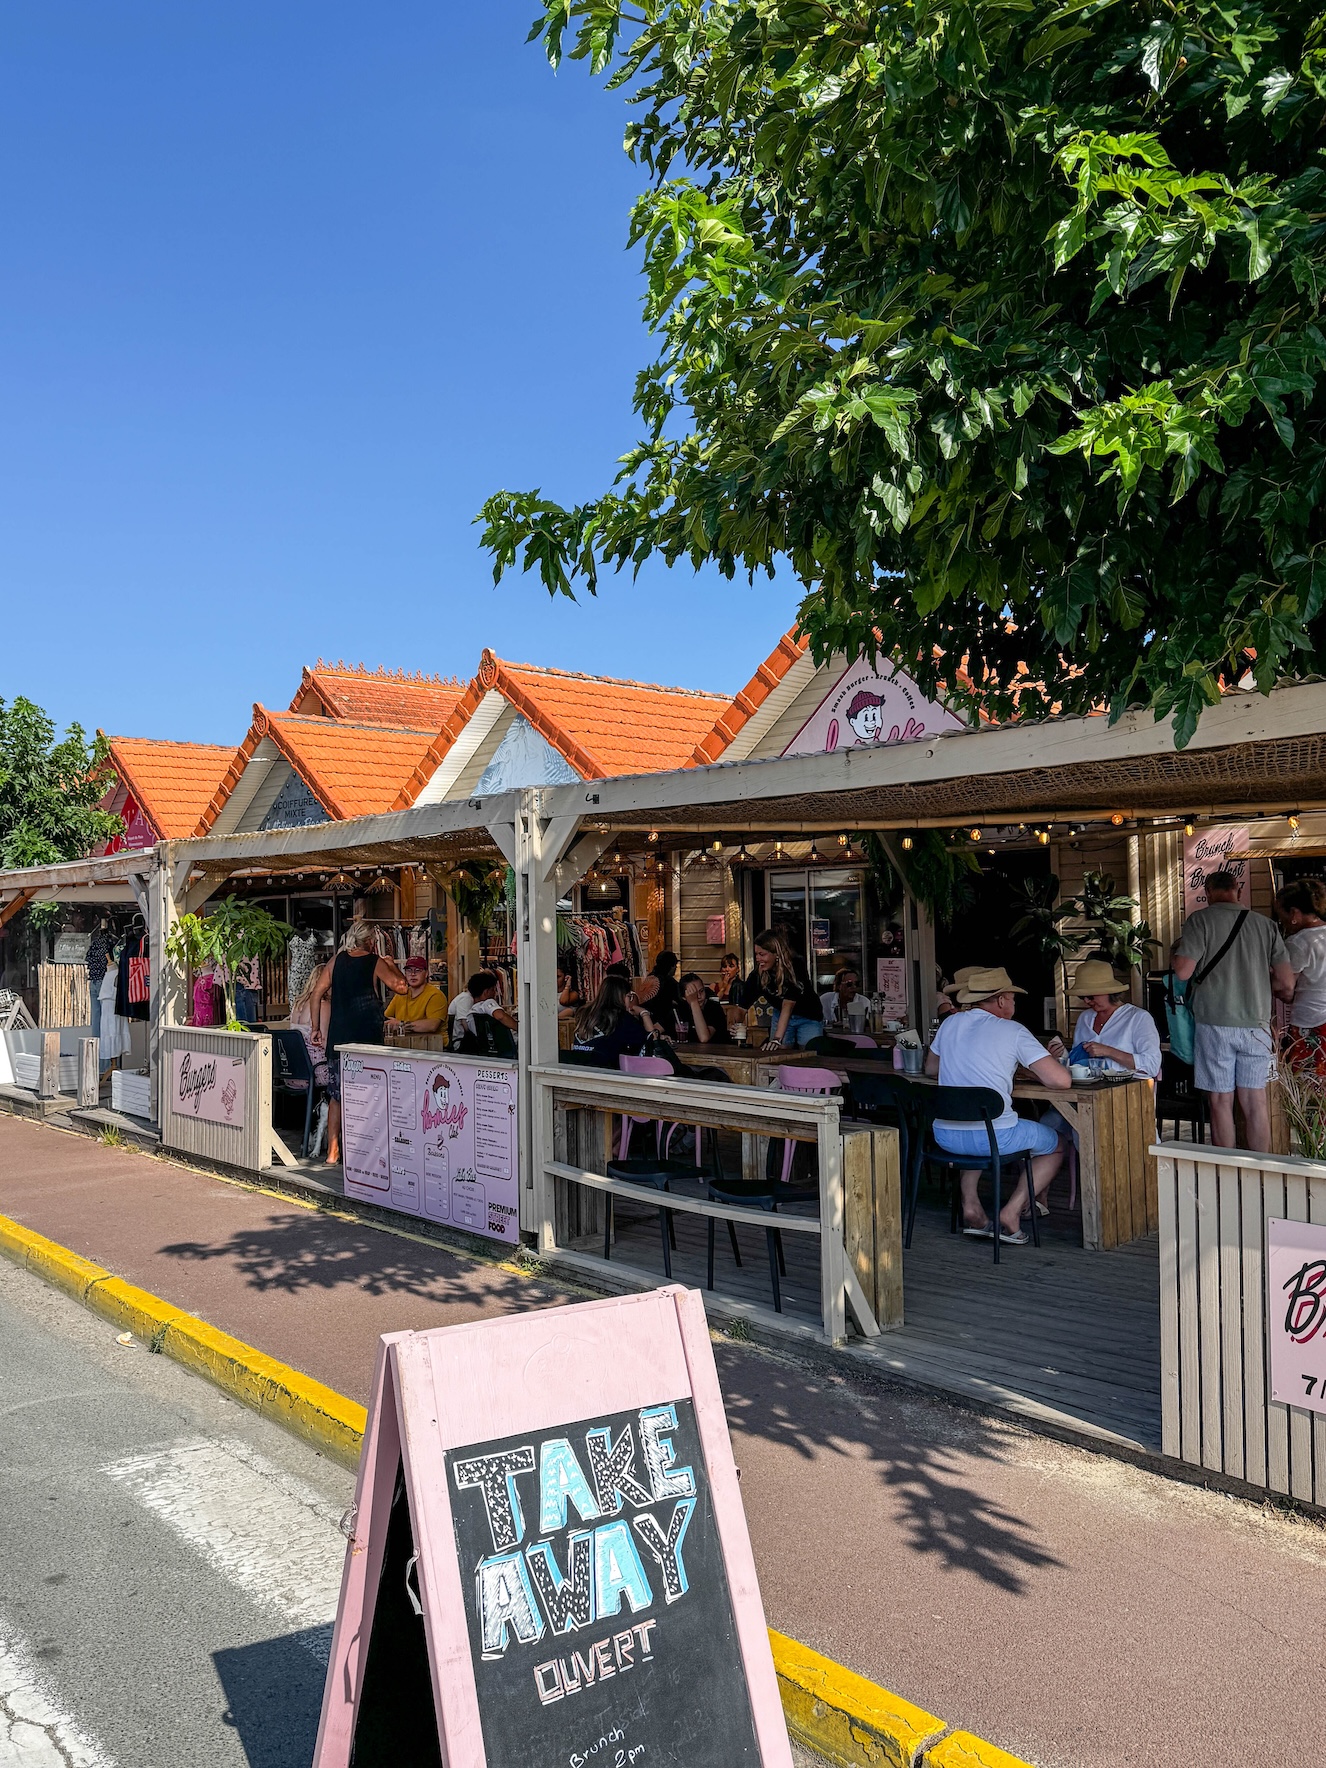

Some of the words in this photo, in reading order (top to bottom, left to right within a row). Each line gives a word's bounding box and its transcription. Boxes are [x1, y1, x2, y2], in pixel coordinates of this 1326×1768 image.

[846, 675, 869, 691] Burger
[277, 797, 314, 810] COIFFURE
[284, 808, 306, 818] MIXTE
[1195, 832, 1235, 860] Brunch
[179, 1052, 217, 1114] Burgers
[477, 1069, 508, 1080] DESSERTS
[488, 1202, 517, 1217] PREMIUM
[488, 1221, 506, 1234] FOOD
[1282, 1259, 1326, 1344] B
[453, 1404, 697, 1552] TAKE
[477, 1497, 697, 1656] AWAY
[533, 1618, 656, 1704] OUVERT
[569, 1727, 625, 1768] Brunch
